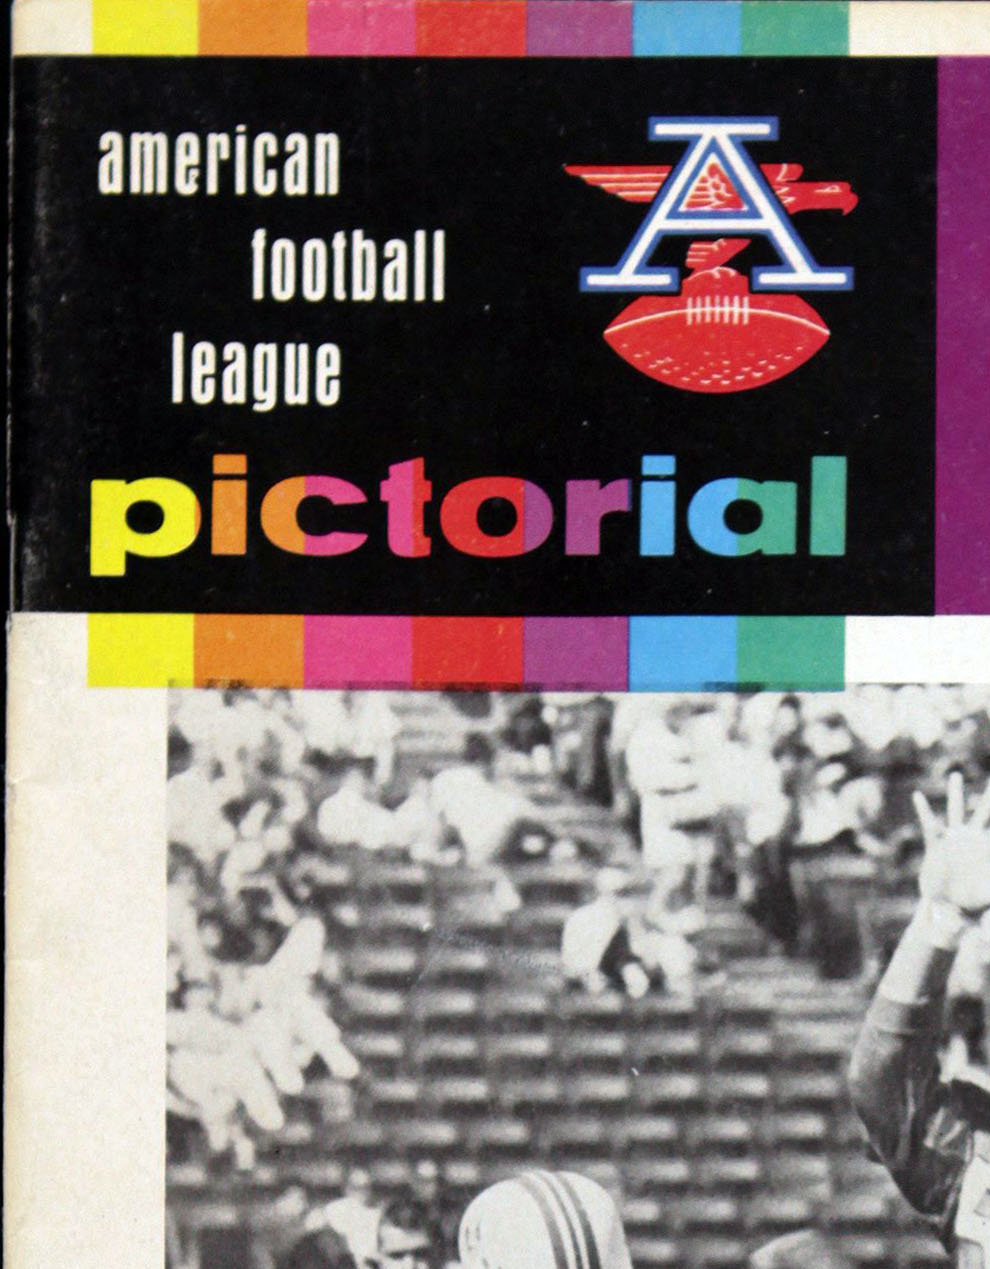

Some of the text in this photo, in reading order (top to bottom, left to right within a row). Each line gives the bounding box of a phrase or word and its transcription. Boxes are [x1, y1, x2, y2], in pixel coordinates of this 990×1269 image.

[98, 125, 339, 196] american
[252, 229, 444, 301] football
[172, 332, 340, 412] league
[90, 454, 846, 576] pictorial
